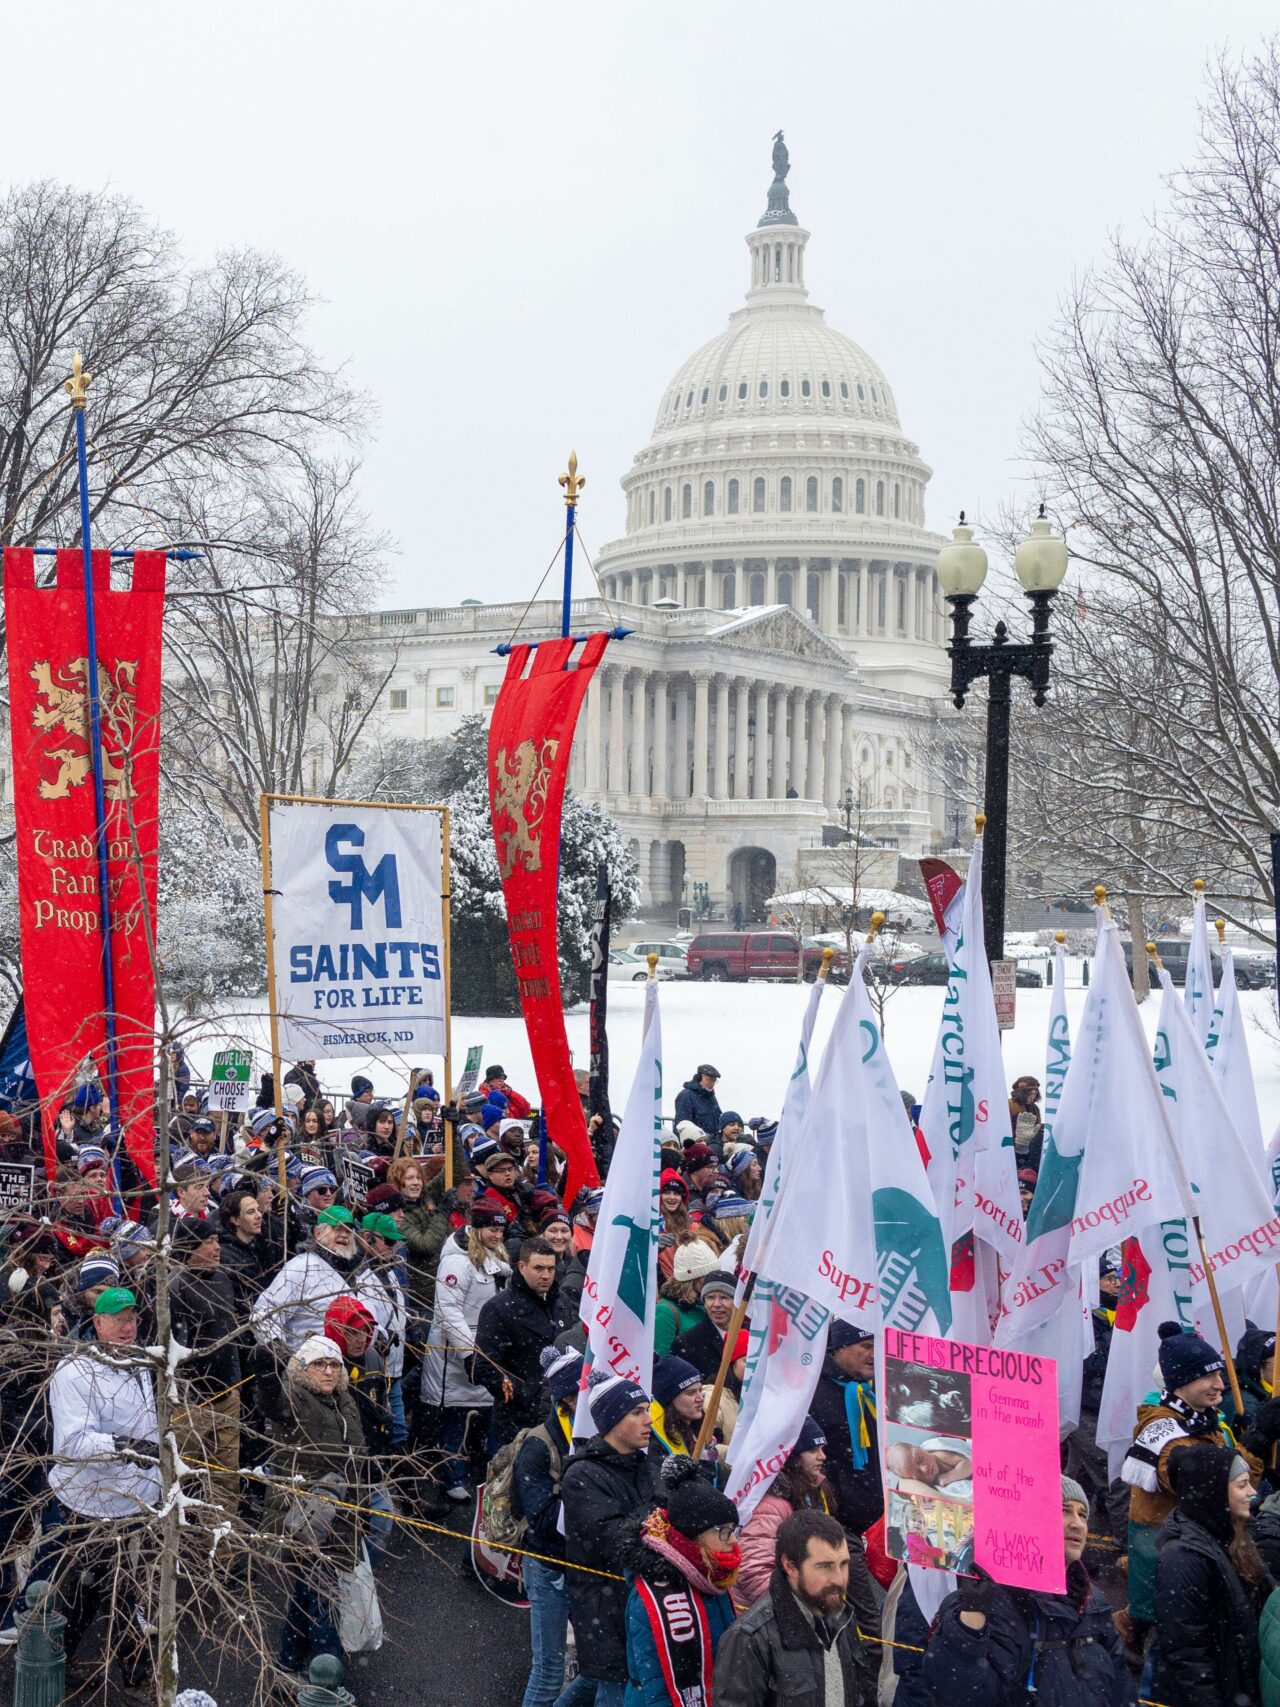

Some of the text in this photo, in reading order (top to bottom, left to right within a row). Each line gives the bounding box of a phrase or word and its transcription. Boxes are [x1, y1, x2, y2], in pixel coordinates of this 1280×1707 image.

[289, 942, 441, 983] SAINTS
[313, 985, 423, 1010] FOR LIFE
[394, 1031, 414, 1042] ND
[213, 1082, 245, 1096] CHOOSE
[220, 1097, 237, 1110] LIFE
[0, 1173, 26, 1184] THE
[885, 1331, 1043, 1385] LIFE IS PRECIOUS
[988, 1386, 1030, 1411] Gemma
[976, 1406, 1045, 1430] in the womb
[976, 1463, 1034, 1487] out of the
[988, 1483, 1021, 1501] womb
[985, 1528, 1041, 1556] ALWAYS
[992, 1547, 1044, 1574] GEMMA!
